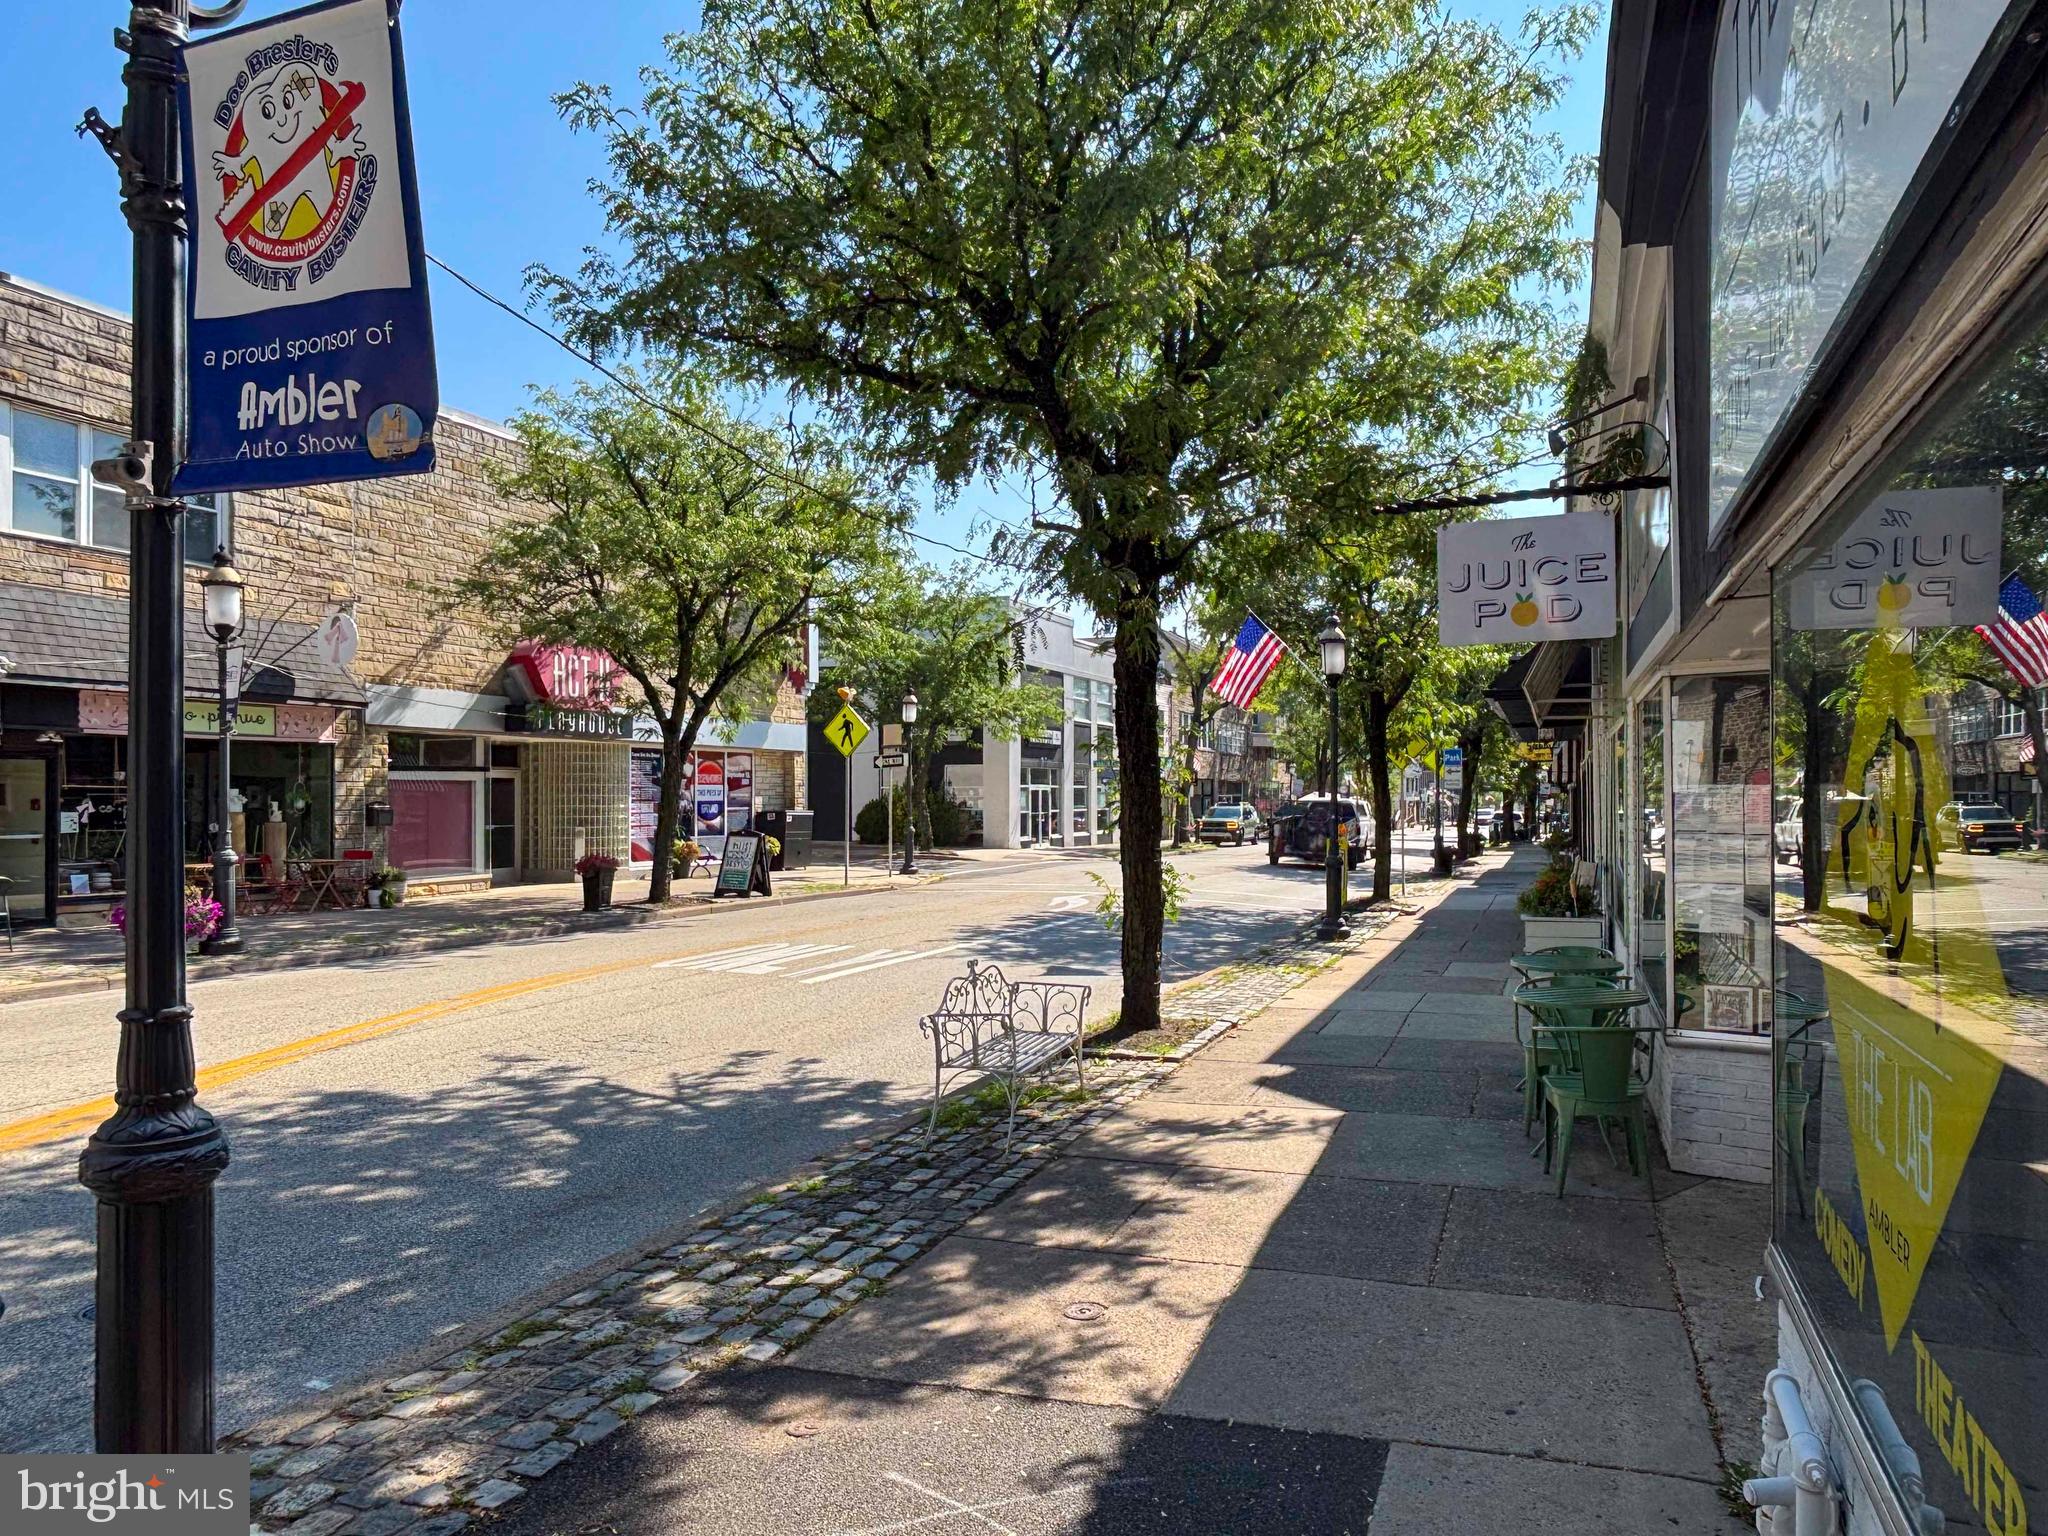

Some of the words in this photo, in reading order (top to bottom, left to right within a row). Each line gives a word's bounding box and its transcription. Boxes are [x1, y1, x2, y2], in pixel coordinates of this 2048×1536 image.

[214, 71, 249, 130] Doc
[245, 34, 339, 80] Bresler's
[225, 242, 302, 291] CAVITY
[308, 154, 377, 284] BUSTERS
[248, 174, 351, 257] www.cavitybusters.com
[203, 350, 216, 366] a
[222, 337, 280, 370] proud
[287, 328, 357, 361] sponsor
[366, 320, 393, 344] of
[237, 373, 361, 430] Ambler
[235, 439, 287, 460] Auto
[298, 433, 356, 454] Show
[1511, 531, 1536, 552] The
[1447, 552, 1608, 593] JUICE
[553, 650, 591, 698] ACT
[538, 710, 622, 735] PLAYHOUSE
[1852, 1029, 1886, 1156] THE
[1895, 1061, 1934, 1207] LAB
[1814, 1184, 1867, 1313] COMEDY
[1868, 1197, 1911, 1273] AMBLER
